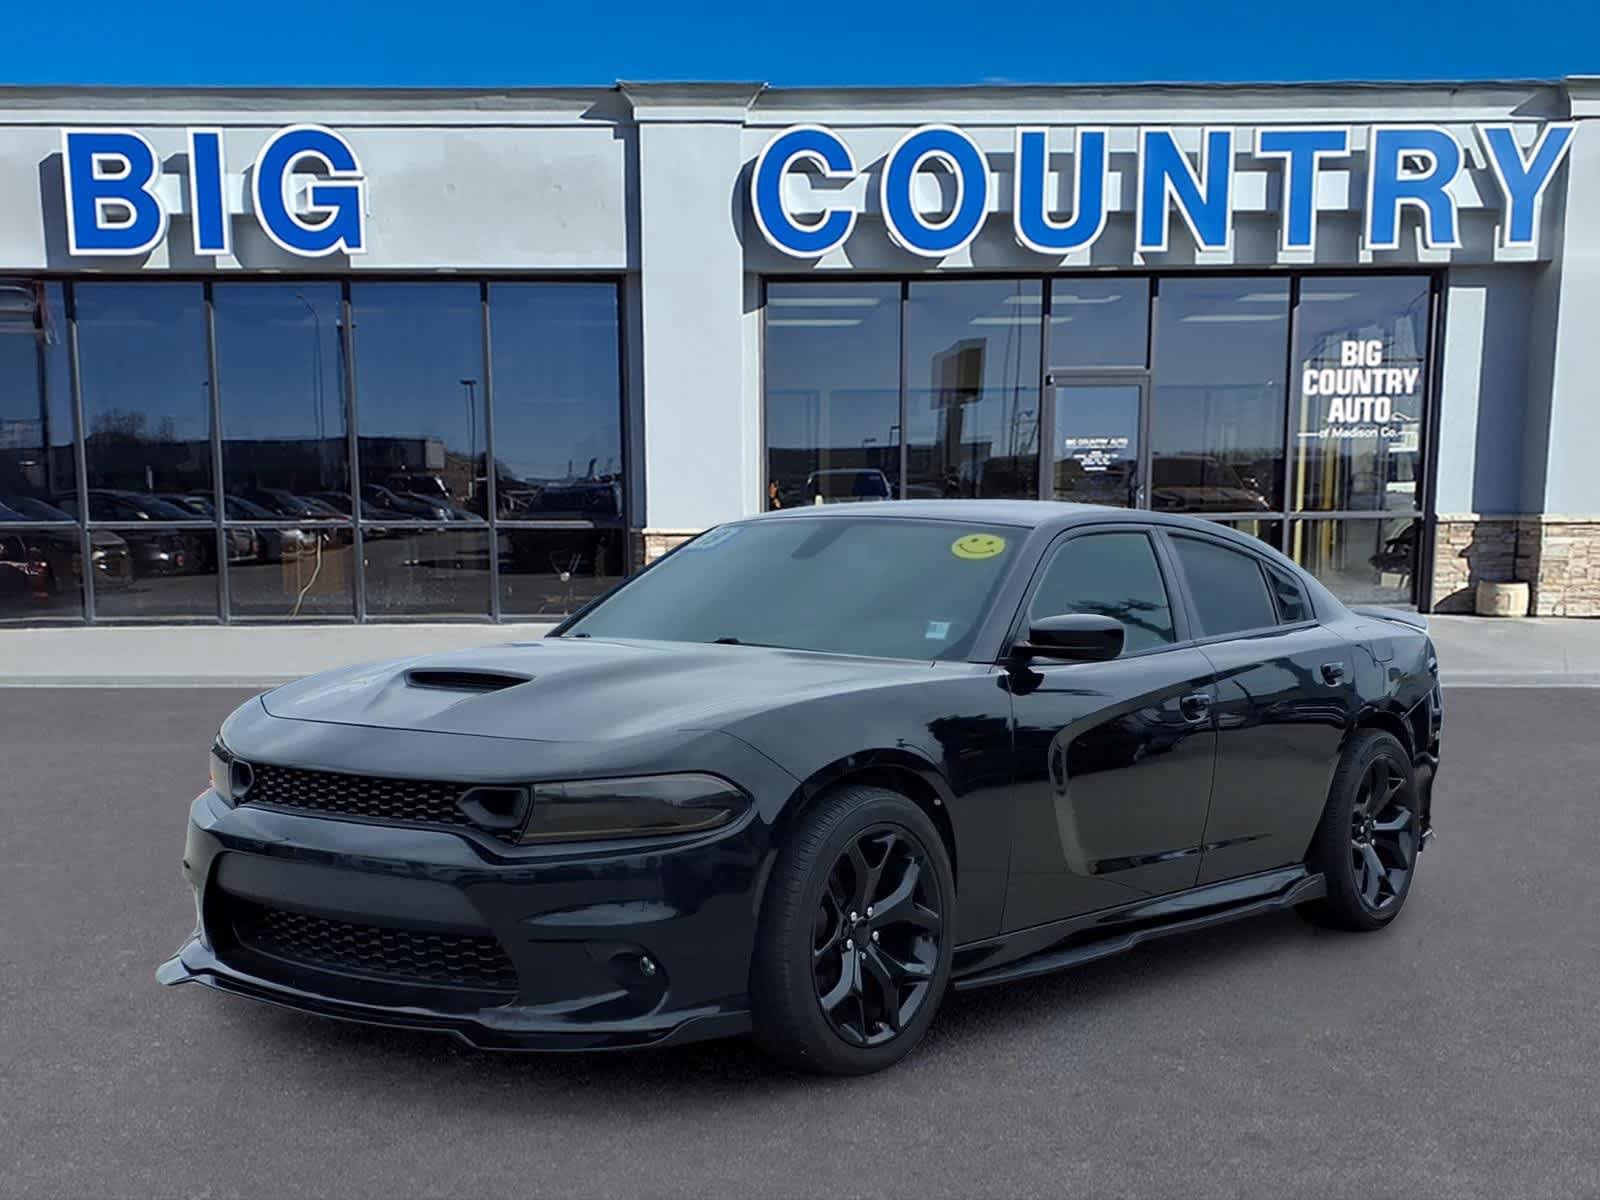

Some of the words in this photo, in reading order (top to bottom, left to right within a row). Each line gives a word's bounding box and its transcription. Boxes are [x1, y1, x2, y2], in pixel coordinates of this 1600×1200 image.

[60, 124, 367, 257] BIG
[751, 123, 1575, 258] COUNTRY
[1341, 340, 1382, 367] BIG
[1303, 368, 1419, 396] COUNTRY
[1328, 397, 1391, 423] AUTO
[1319, 427, 1330, 438] of
